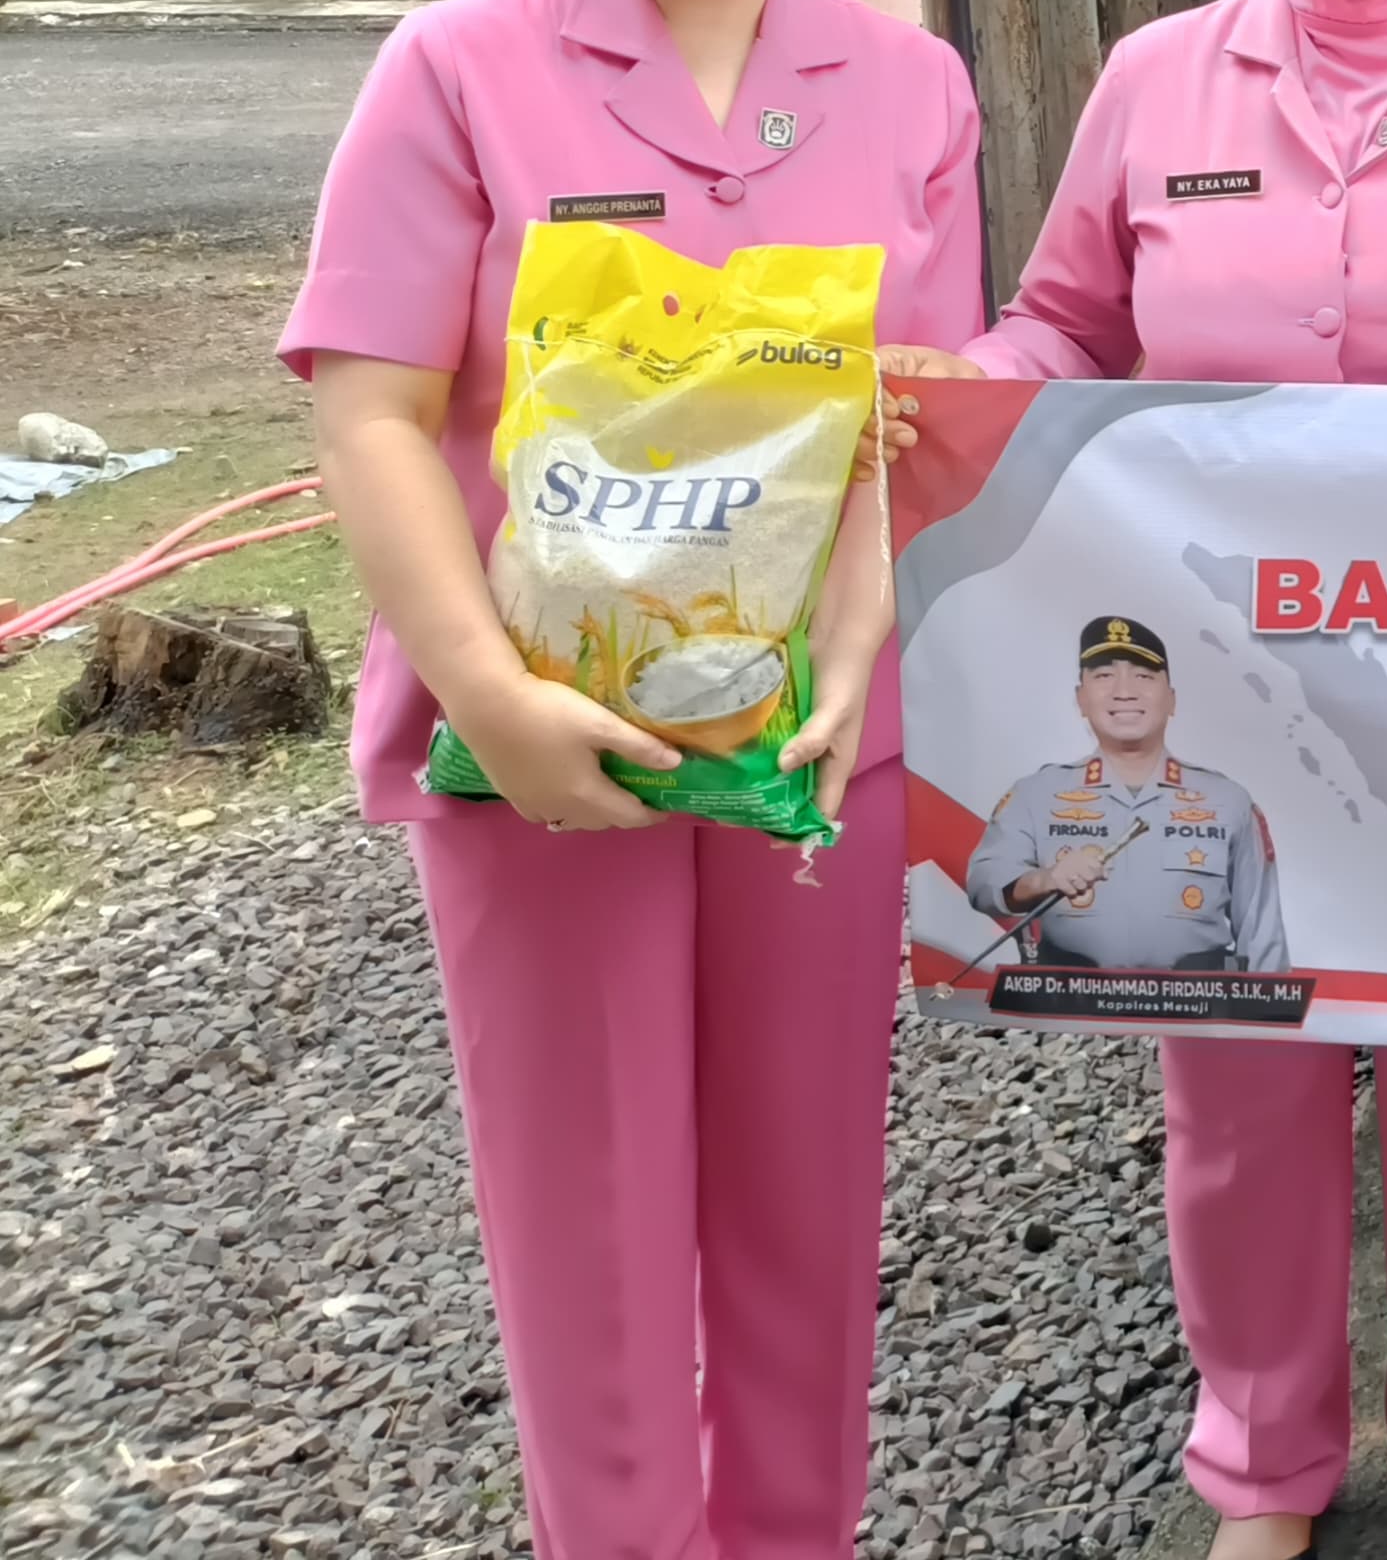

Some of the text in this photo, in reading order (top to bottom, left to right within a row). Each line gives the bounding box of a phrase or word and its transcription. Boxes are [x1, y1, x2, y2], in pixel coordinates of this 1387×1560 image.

[1177, 176, 1250, 193] NY. EKA YAYA
[572, 202, 610, 214] ANGGIE
[760, 341, 842, 371] bulog
[534, 460, 763, 533] SPHP
[612, 773, 677, 788] merintah
[1049, 824, 1109, 838] FIRDAUS
[1164, 825, 1226, 840] POLRI
[1004, 975, 1042, 992] AKBP
[1046, 978, 1066, 993] Dr.
[1069, 978, 1158, 997] MUHAMMAD
[1162, 981, 1228, 1000] FIRDAUS,
[1274, 984, 1302, 1001] M.H
[1097, 999, 1209, 1015] Kapolres Mesuji
